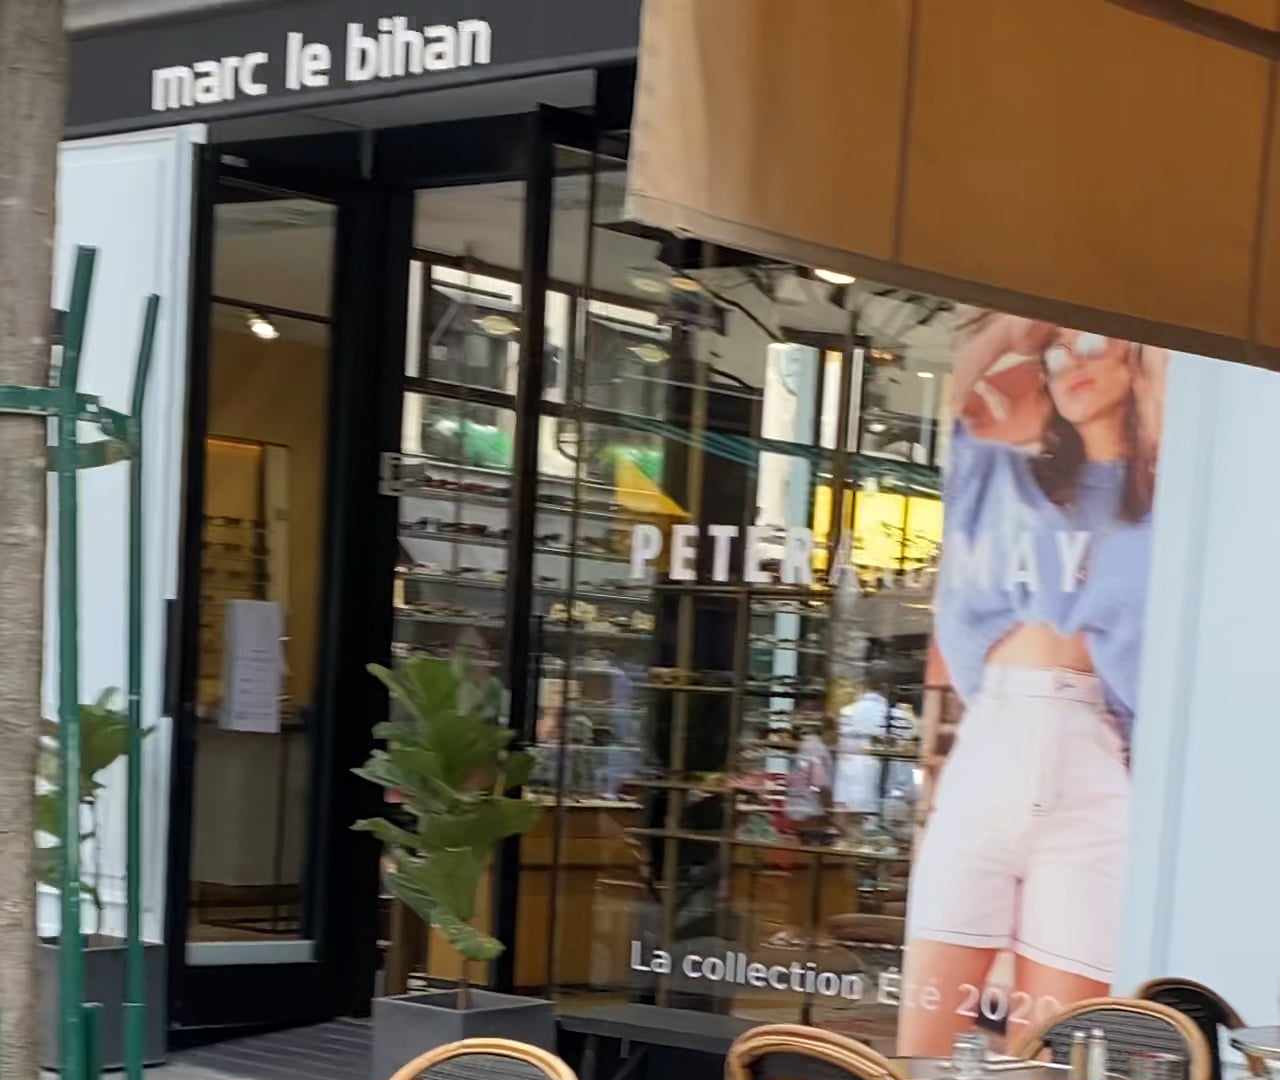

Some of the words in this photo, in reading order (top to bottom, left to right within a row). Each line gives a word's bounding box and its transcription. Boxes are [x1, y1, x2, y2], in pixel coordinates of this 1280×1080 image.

[151, 52, 269, 112] marc
[285, 31, 332, 91] le
[345, 15, 492, 82] bihan
[629, 524, 813, 585] PETER
[951, 529, 1091, 593] MAY
[630, 940, 672, 974] La
[682, 950, 863, 1001] collection
